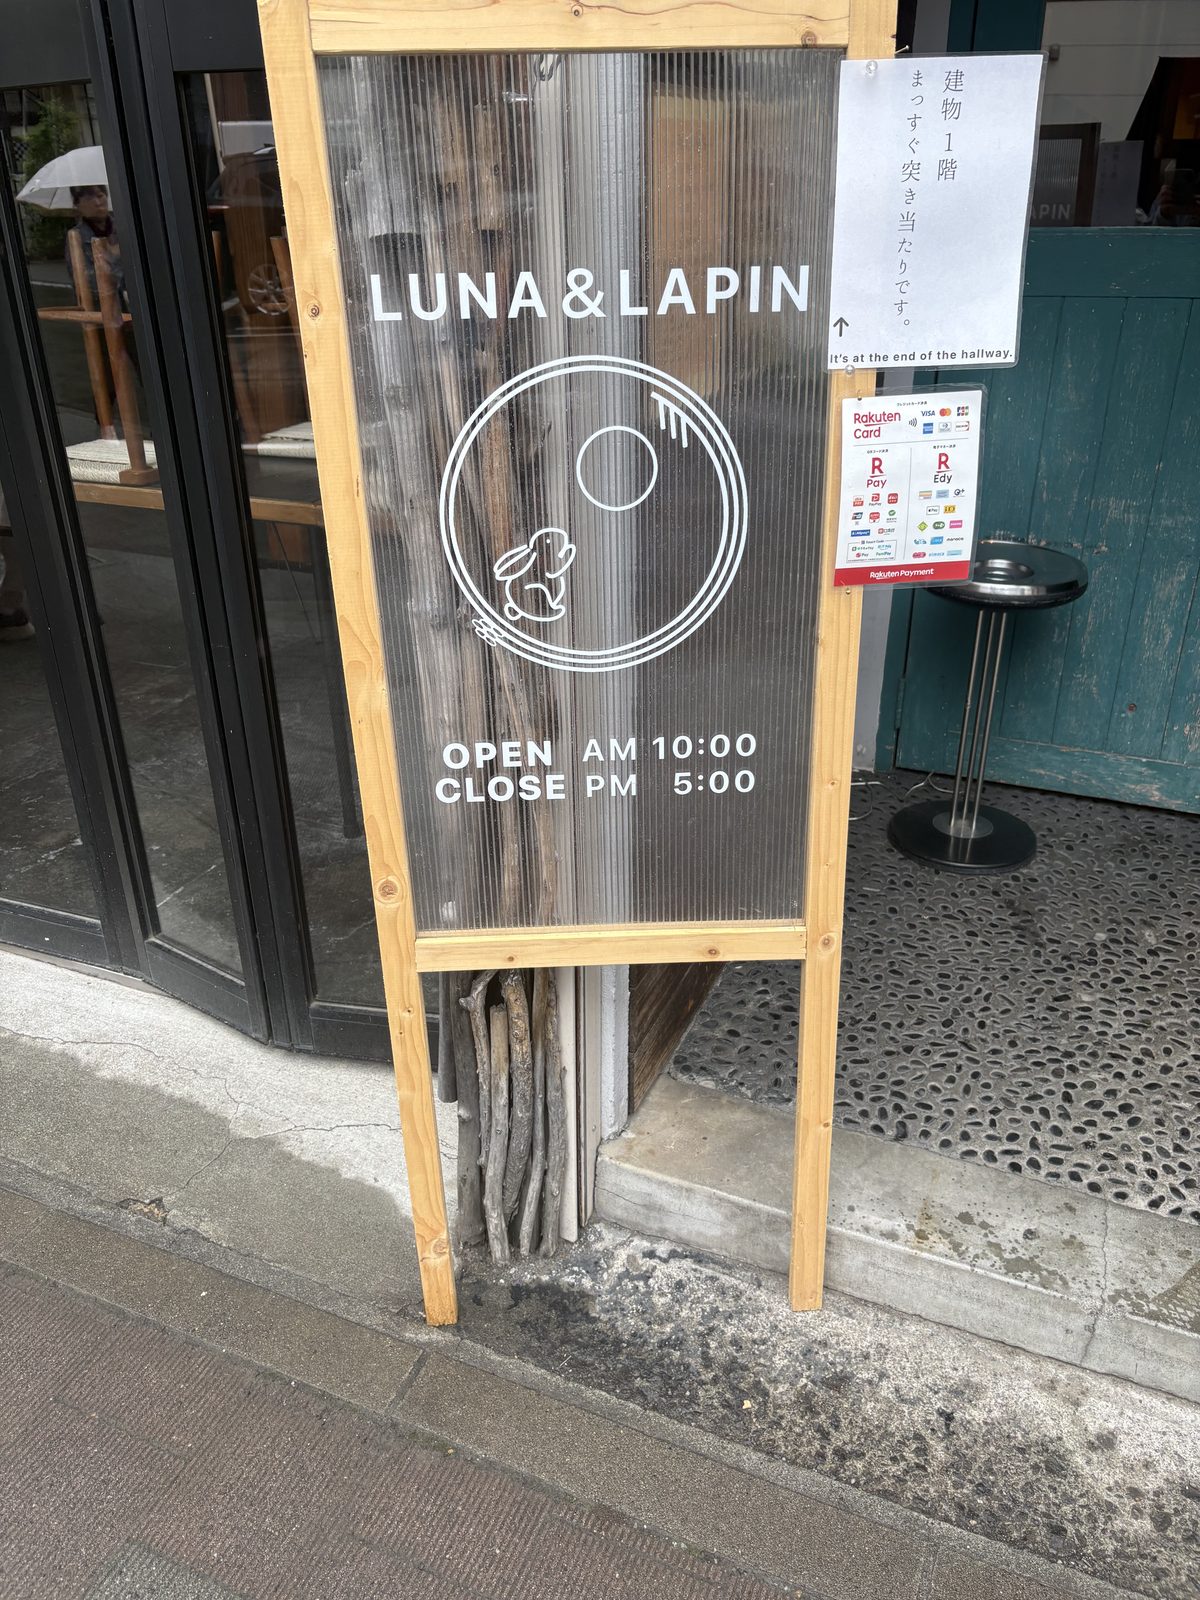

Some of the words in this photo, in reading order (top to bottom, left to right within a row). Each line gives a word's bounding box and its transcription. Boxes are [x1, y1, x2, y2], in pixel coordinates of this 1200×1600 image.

[937, 68, 966, 182] 建物1階
[893, 69, 924, 327] まっすぐ突き当たりです。
[370, 271, 547, 322] LUNA
[561, 267, 607, 319] &
[619, 265, 810, 316] LAPIN
[852, 353, 866, 363] at
[869, 351, 889, 362] the
[893, 350, 916, 361] end
[920, 349, 934, 361] of
[937, 349, 957, 361] the
[961, 348, 1013, 362] hallway.
[853, 411, 901, 425] Rakuten
[853, 427, 881, 439] Card
[871, 457, 884, 476] R
[937, 453, 950, 471] R
[866, 478, 887, 489] Pay
[933, 474, 953, 484] Edy
[869, 571, 900, 580] Rakuten
[900, 568, 935, 577] Payment
[442, 740, 553, 770] OPEN
[582, 737, 637, 762] AM
[652, 733, 757, 760] 10:00
[435, 774, 566, 803] CLOSE
[586, 774, 637, 798] PM
[673, 769, 756, 796] 5:00
